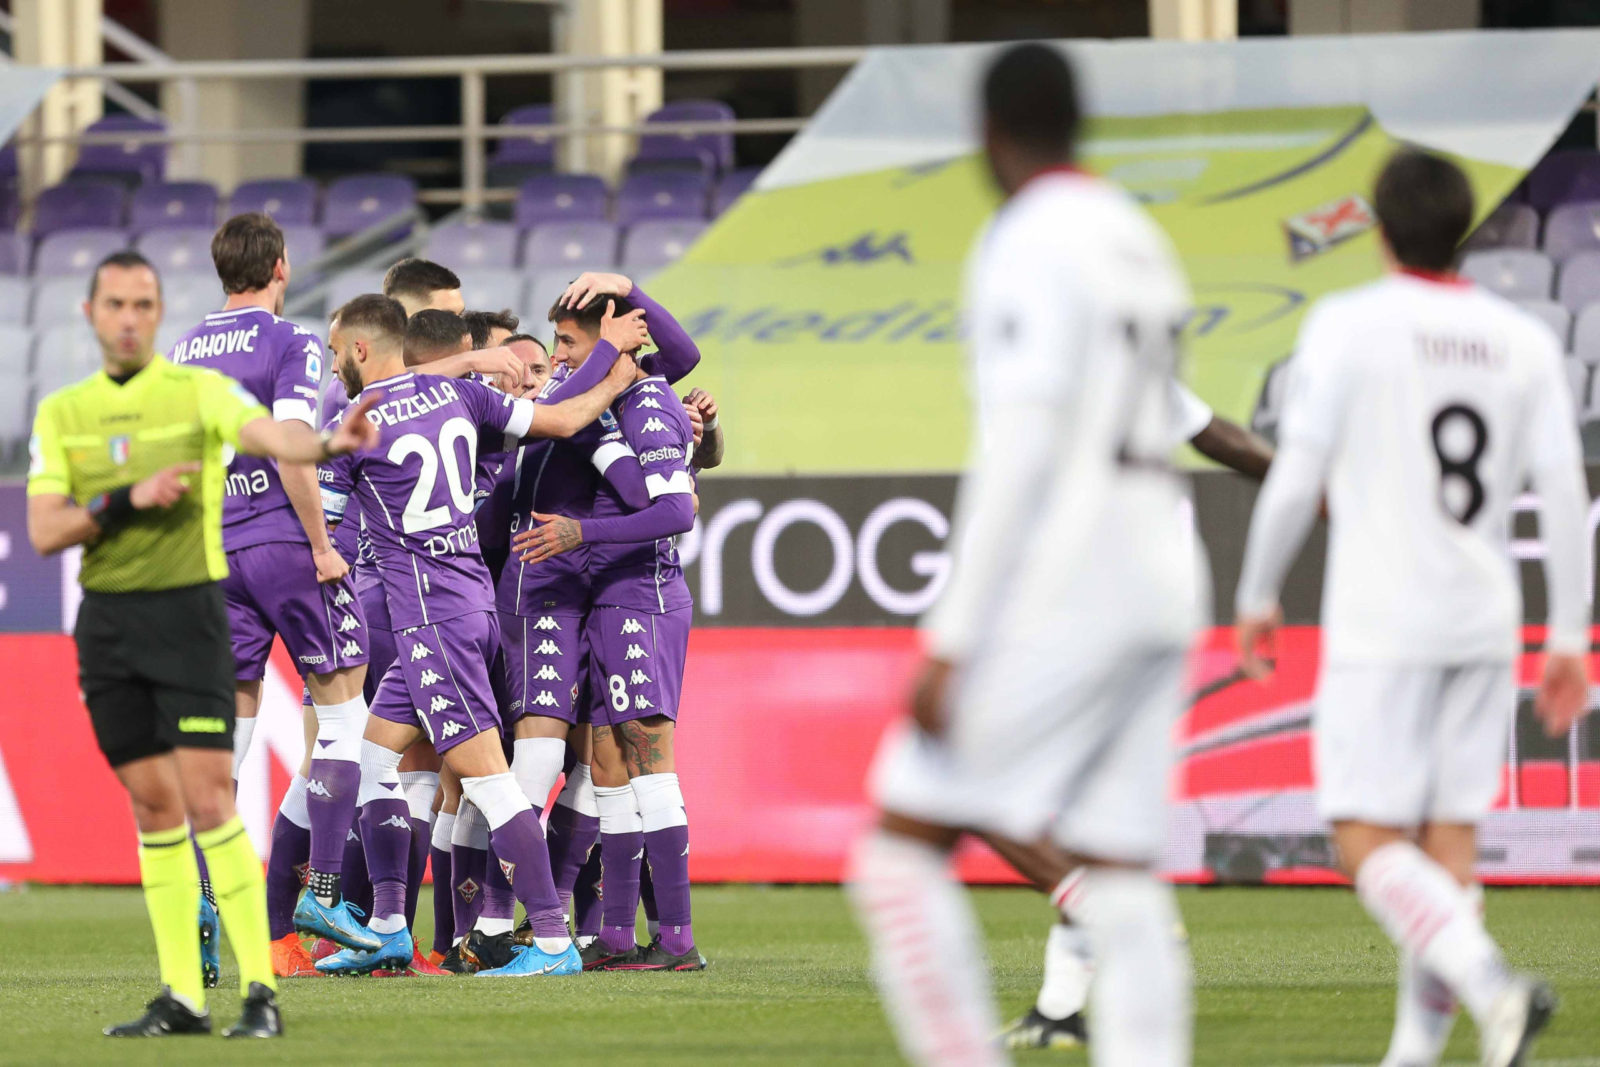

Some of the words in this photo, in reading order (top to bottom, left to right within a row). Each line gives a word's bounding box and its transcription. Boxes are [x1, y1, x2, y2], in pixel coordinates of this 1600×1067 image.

[173, 324, 259, 366] VLAHOVIĆ
[364, 381, 460, 432] PEZZELLA
[386, 416, 478, 535] 20
[1431, 402, 1488, 525] 8
[609, 674, 630, 713] 8
